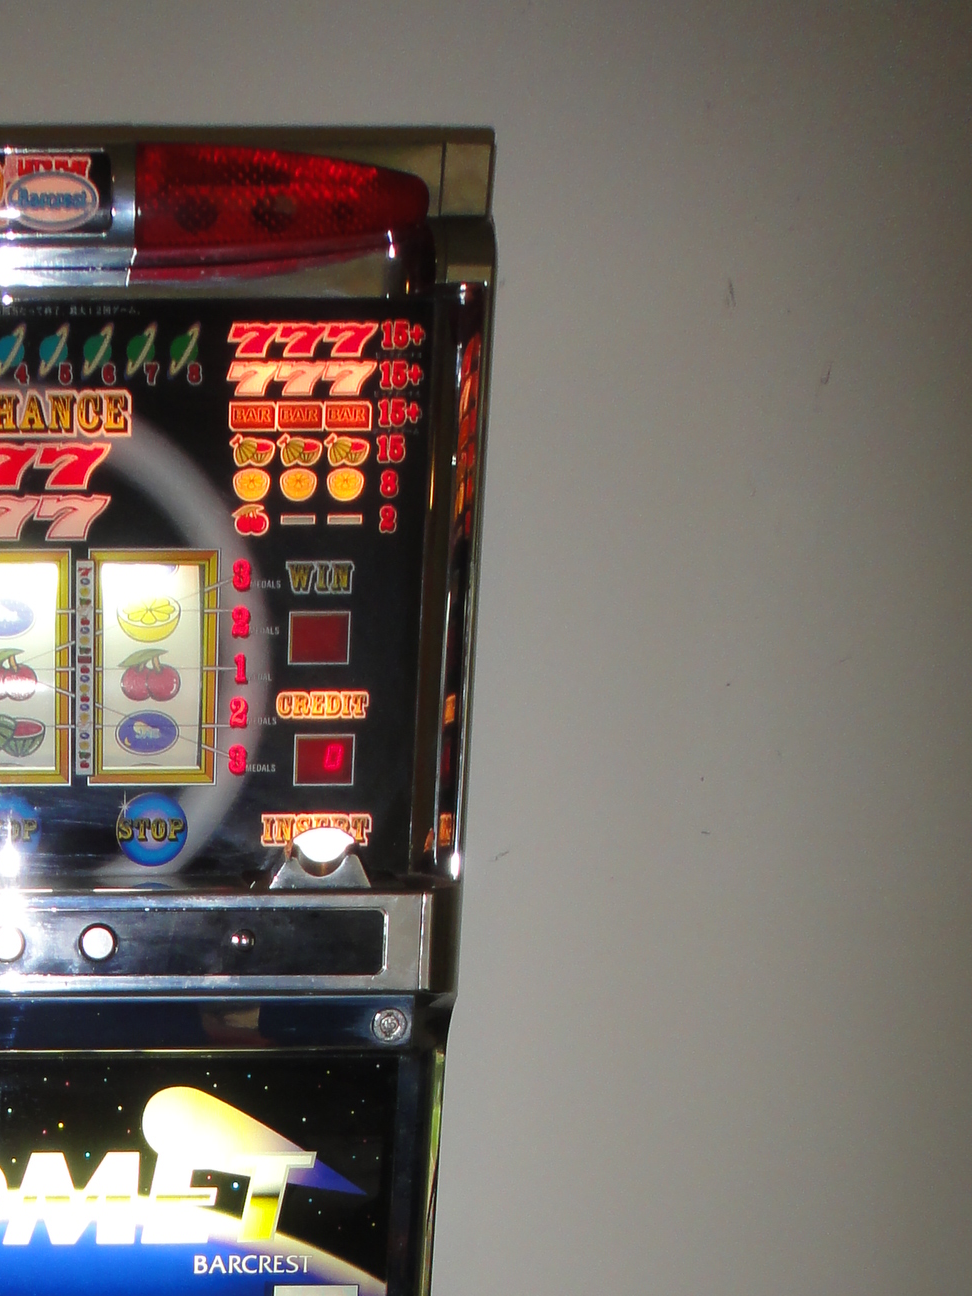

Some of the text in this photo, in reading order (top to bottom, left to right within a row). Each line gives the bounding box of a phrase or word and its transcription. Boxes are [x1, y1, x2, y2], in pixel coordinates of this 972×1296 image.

[14, 363, 29, 386] 4
[58, 362, 73, 385] 5
[101, 362, 117, 385] 6
[144, 362, 160, 386] 7
[186, 362, 203, 386] 8
[232, 405, 273, 424] BAR
[280, 405, 320, 424] BAR
[328, 405, 368, 424] BAR
[376, 433, 406, 464] 15
[379, 468, 400, 498] 8
[378, 503, 398, 534] 2
[232, 559, 252, 592] 3
[286, 560, 356, 594] WIN
[231, 605, 251, 639] 2
[234, 652, 248, 685] 1
[229, 696, 249, 729] 2
[276, 691, 370, 720] CREDIT
[228, 744, 277, 776] 3 MEDALS
[324, 744, 344, 771] 0
[118, 817, 187, 842] STOP
[193, 1254, 313, 1274] BARCREST
